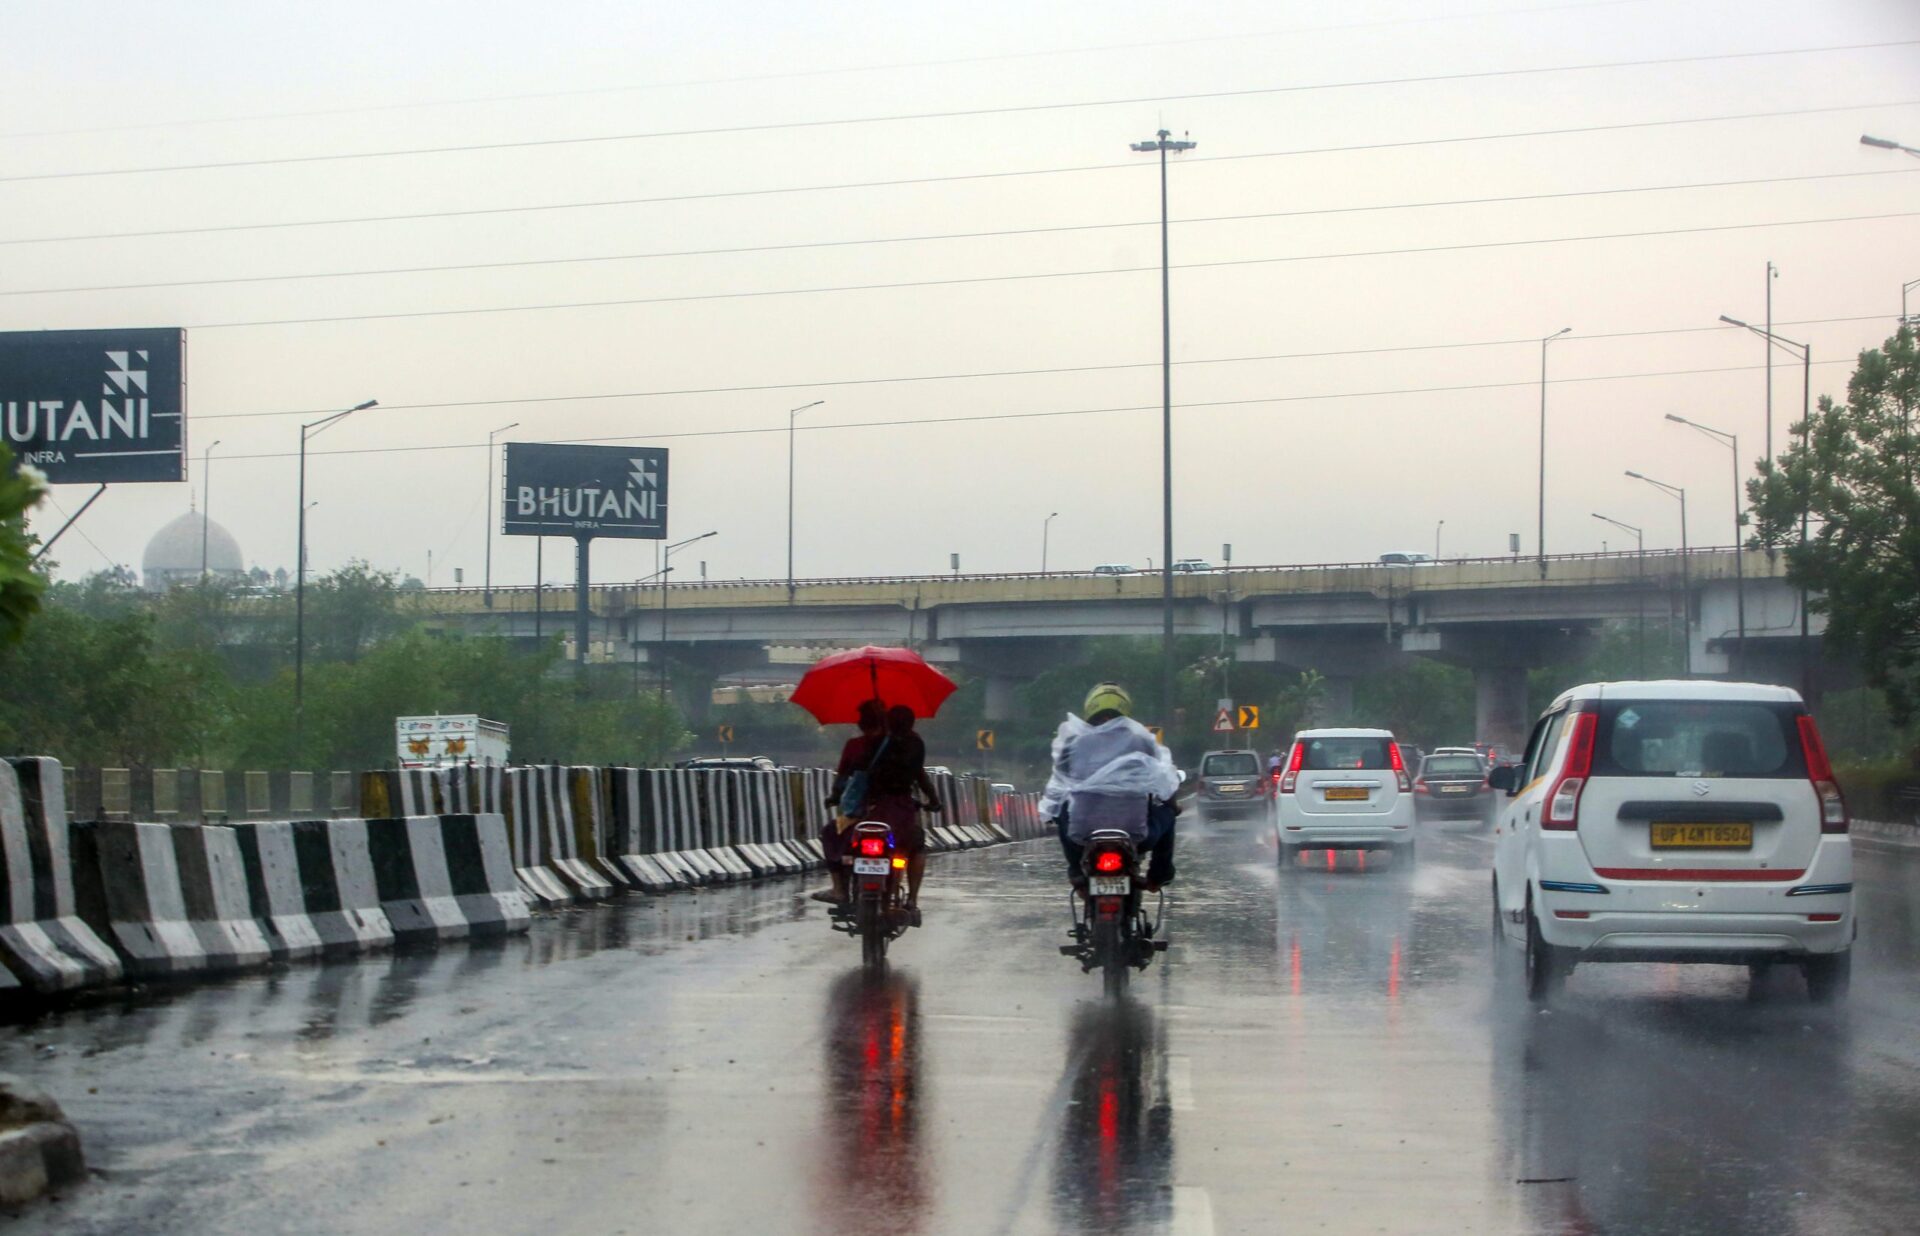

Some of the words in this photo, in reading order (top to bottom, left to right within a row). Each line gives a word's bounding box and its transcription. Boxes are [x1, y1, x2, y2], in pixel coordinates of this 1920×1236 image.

[0, 398, 148, 442] UTANI
[24, 451, 66, 464] INFRA
[518, 486, 657, 519] BHUTANI
[574, 520, 599, 529] INFRA
